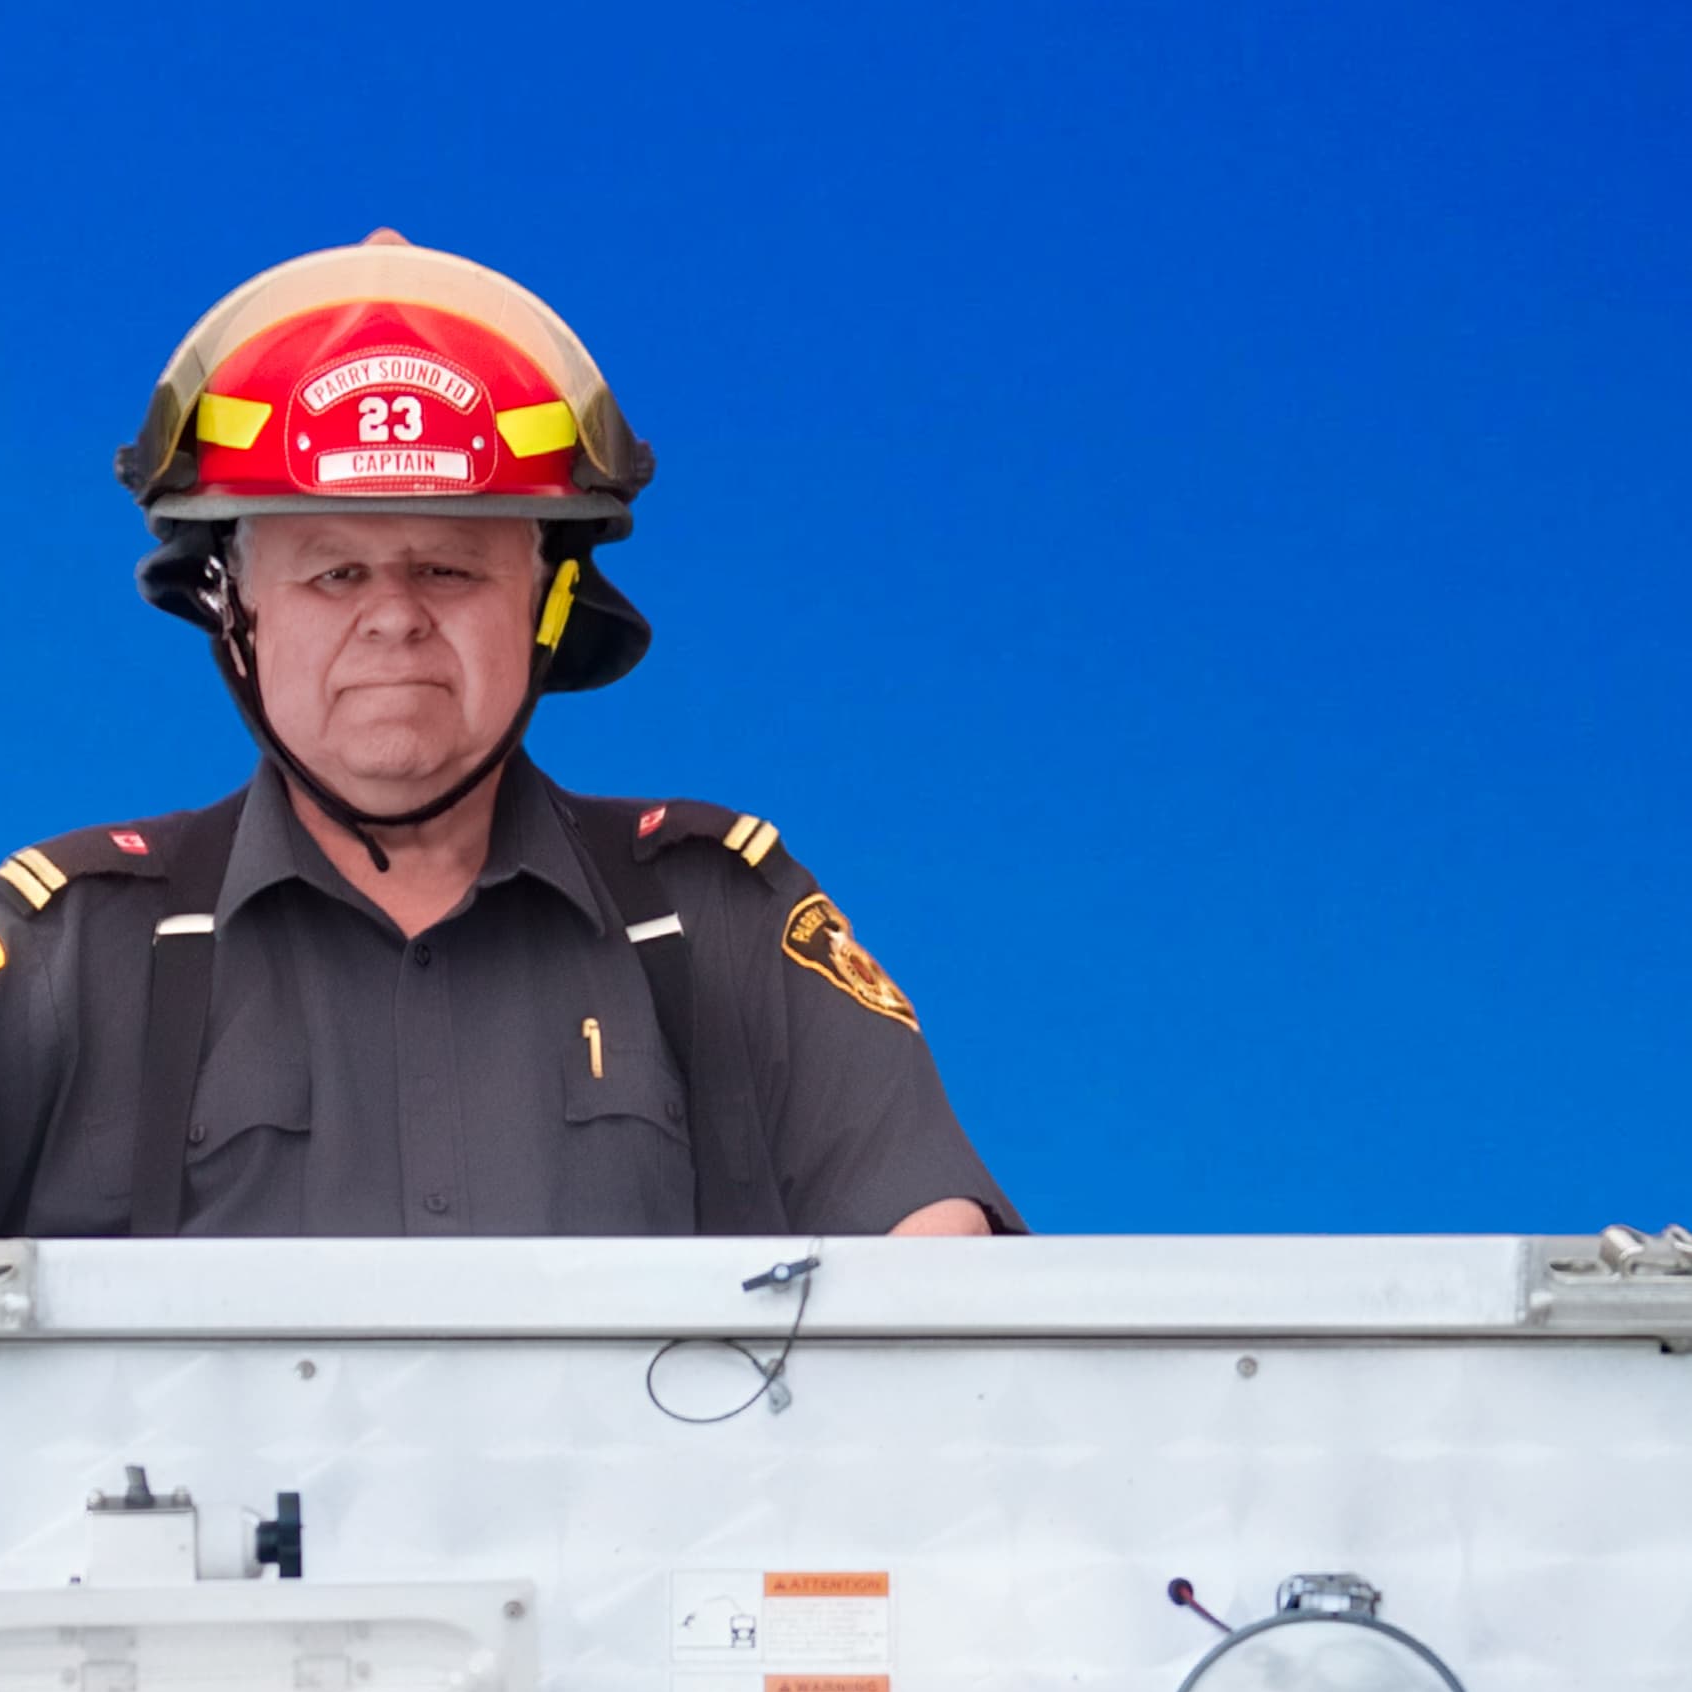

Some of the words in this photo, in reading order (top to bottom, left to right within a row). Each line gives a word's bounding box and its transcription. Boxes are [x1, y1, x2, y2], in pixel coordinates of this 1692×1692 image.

[314, 363, 370, 402] PARRY
[379, 360, 440, 386] SOUND
[445, 374, 467, 401] FD
[358, 396, 423, 442] 23
[353, 452, 435, 474] CAPTAIN
[789, 1576, 882, 1591] ATTENTION
